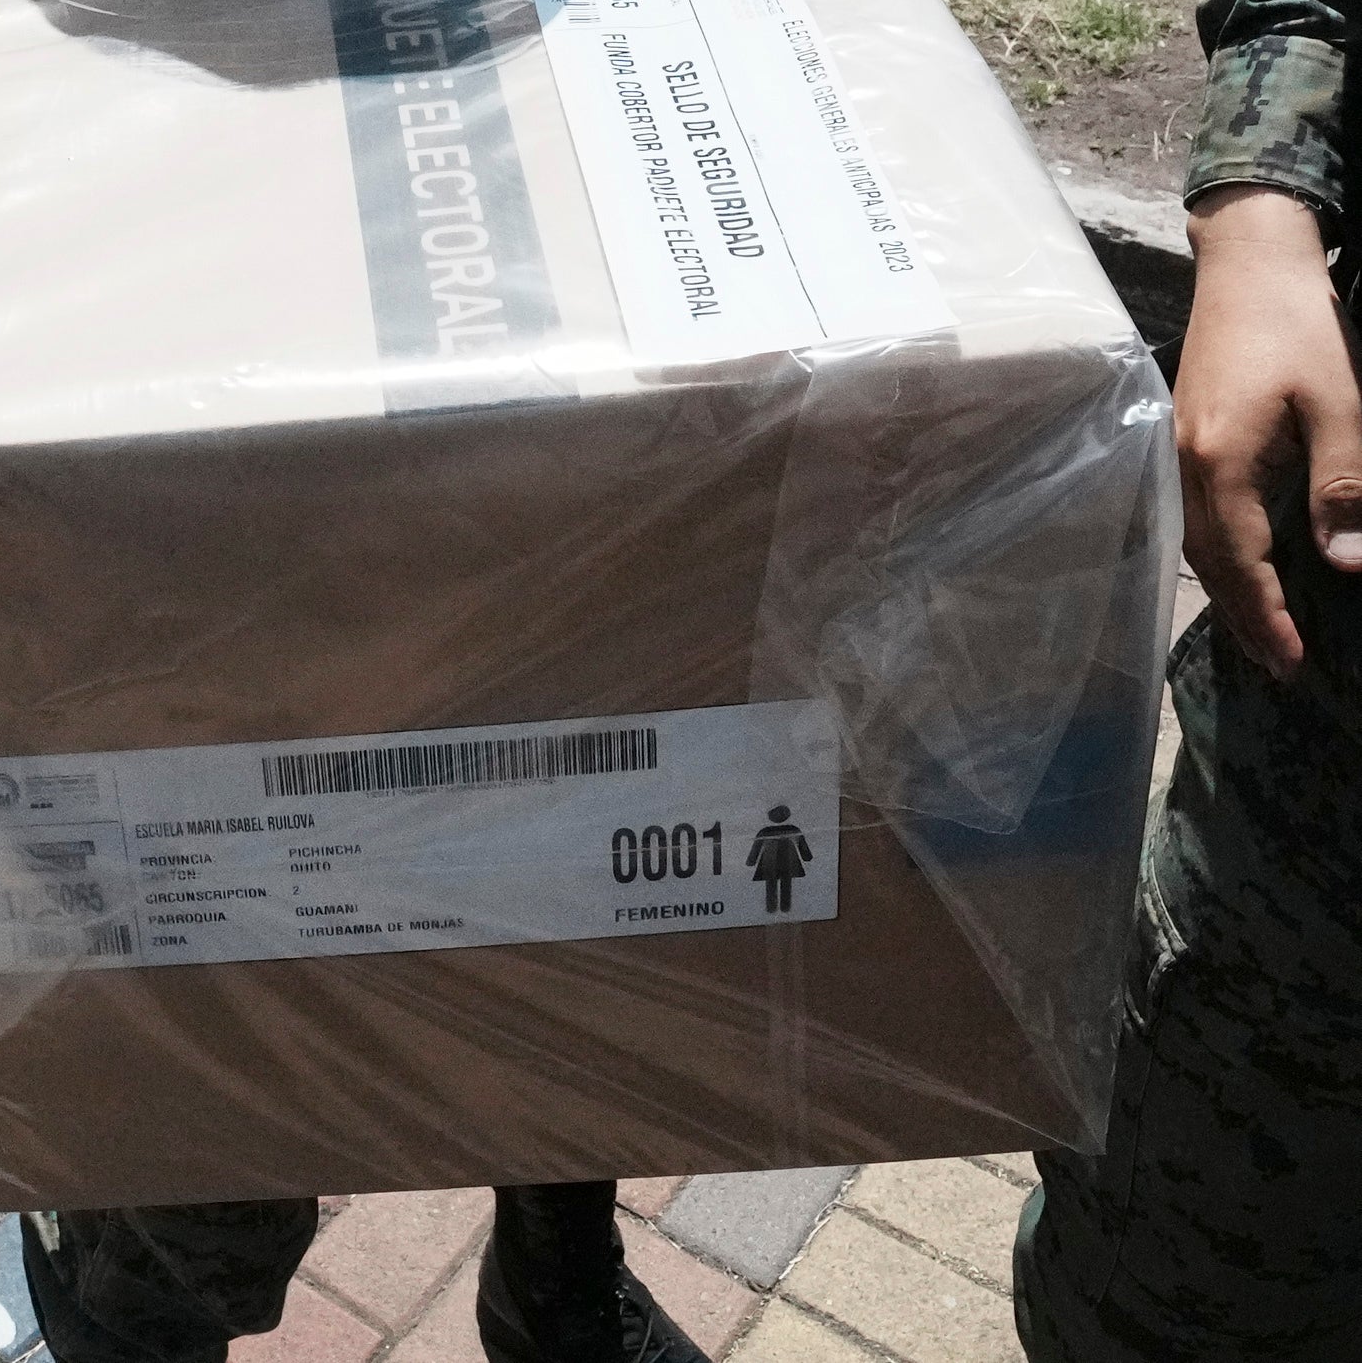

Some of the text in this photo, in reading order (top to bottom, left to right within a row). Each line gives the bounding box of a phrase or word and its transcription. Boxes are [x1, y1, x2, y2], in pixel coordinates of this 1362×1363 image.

[662, 60, 765, 258] SELLO DE SEGURIDAD
[782, 19, 914, 273] ELECCIONES GENERALES ANTICIPADAS 2023
[601, 33, 722, 321] FUNDA COBERTOR PAQUETE ELECTORAL
[397, 98, 510, 360] ELECTORAL
[135, 813, 315, 839] ESCUELA MARIA ISABEL RUILOVA
[288, 844, 363, 858] PICHINCHA
[611, 821, 723, 884] 0001
[295, 903, 359, 918] GUAMANI
[298, 921, 383, 938] TURUBAMBA
[387, 920, 405, 933] DE
[409, 917, 465, 932] MONJAS
[614, 900, 725, 923] FEMENINO
